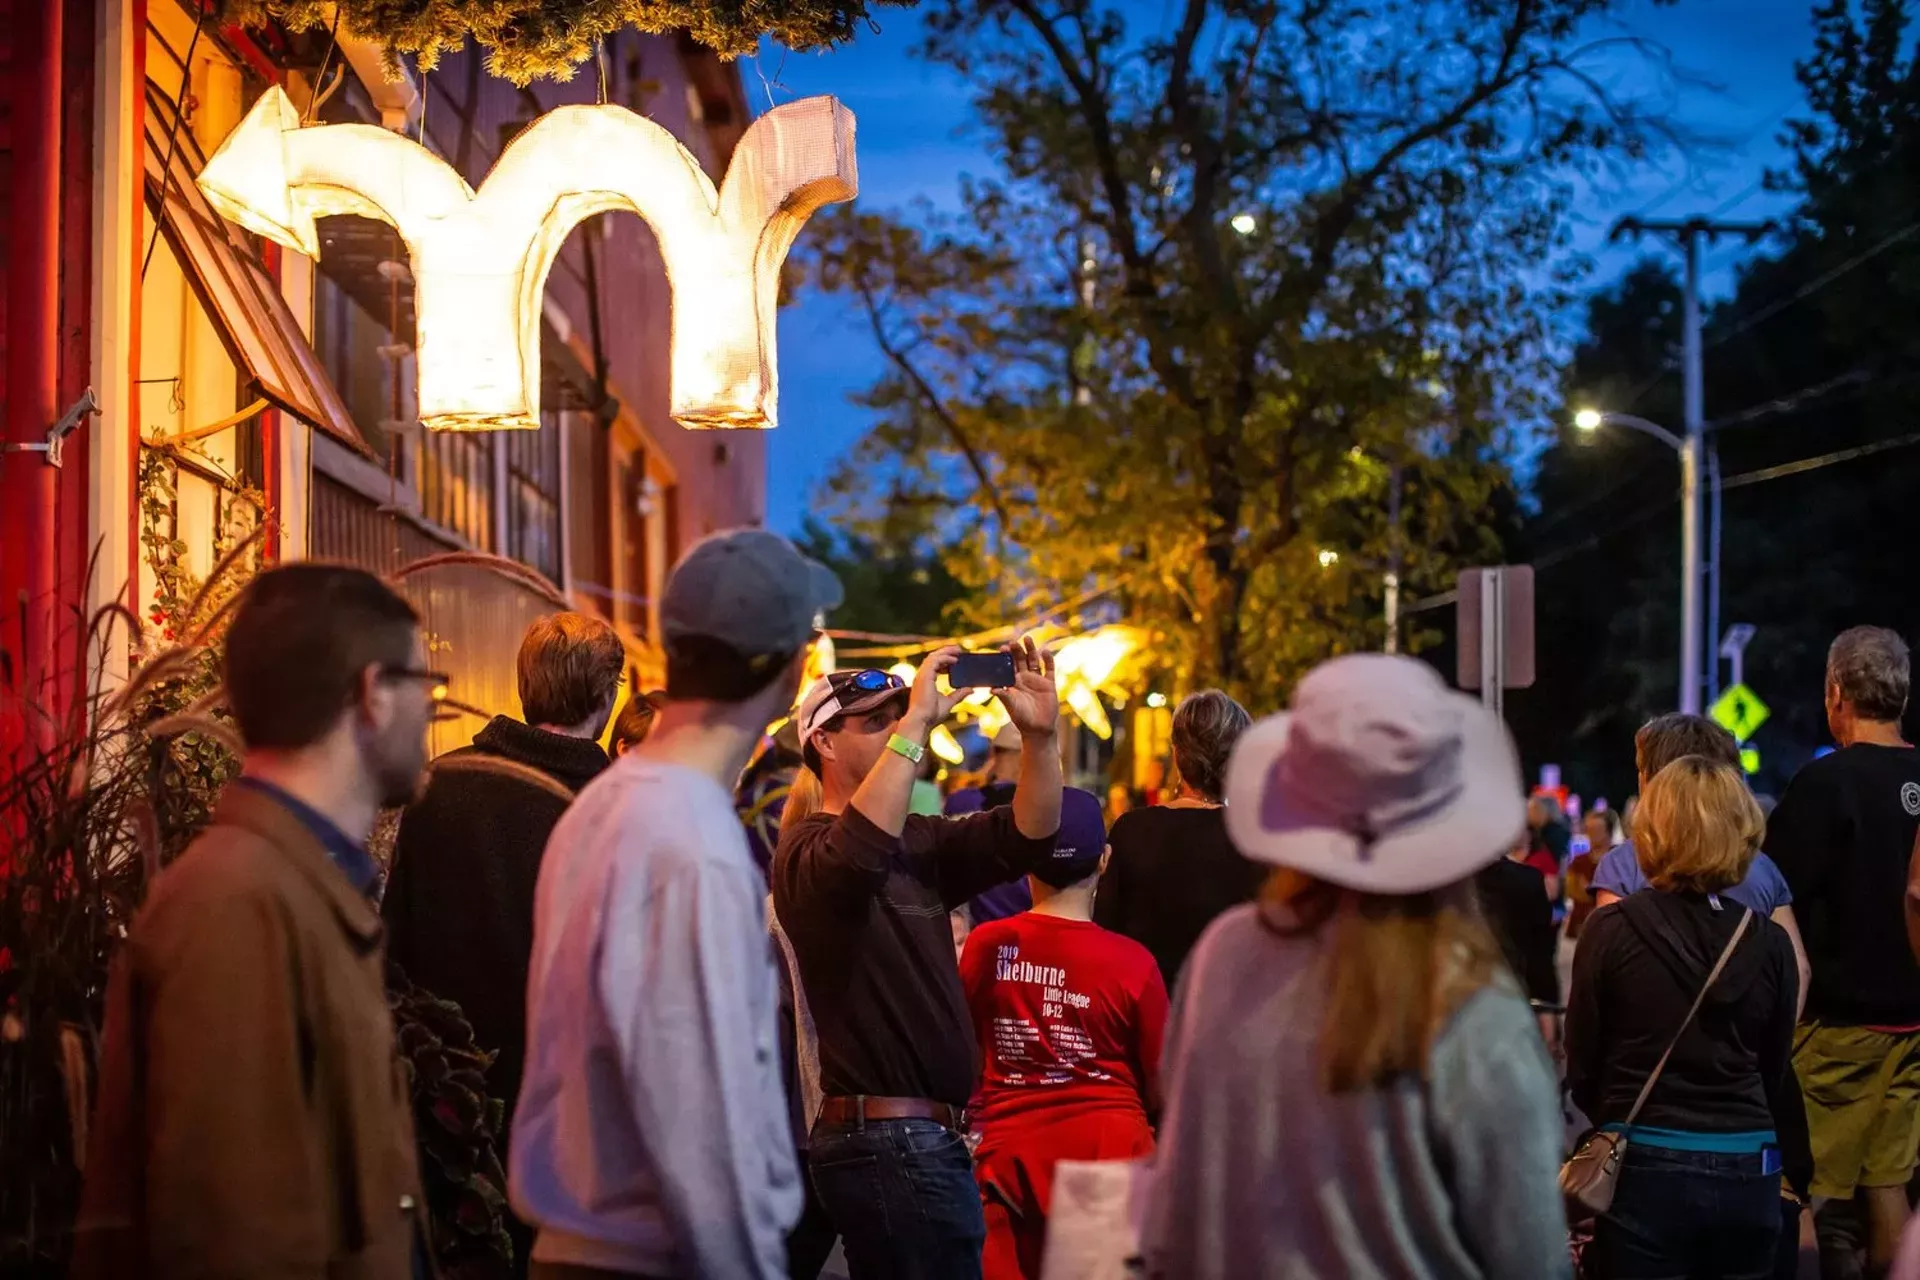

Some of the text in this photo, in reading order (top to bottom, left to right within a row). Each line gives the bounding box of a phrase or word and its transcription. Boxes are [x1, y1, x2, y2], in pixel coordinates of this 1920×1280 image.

[997, 945, 1019, 960] 2019
[996, 959, 1066, 987] Shelburne
[1043, 986, 1091, 1009] Little League
[1042, 1003, 1063, 1018] 10-12
